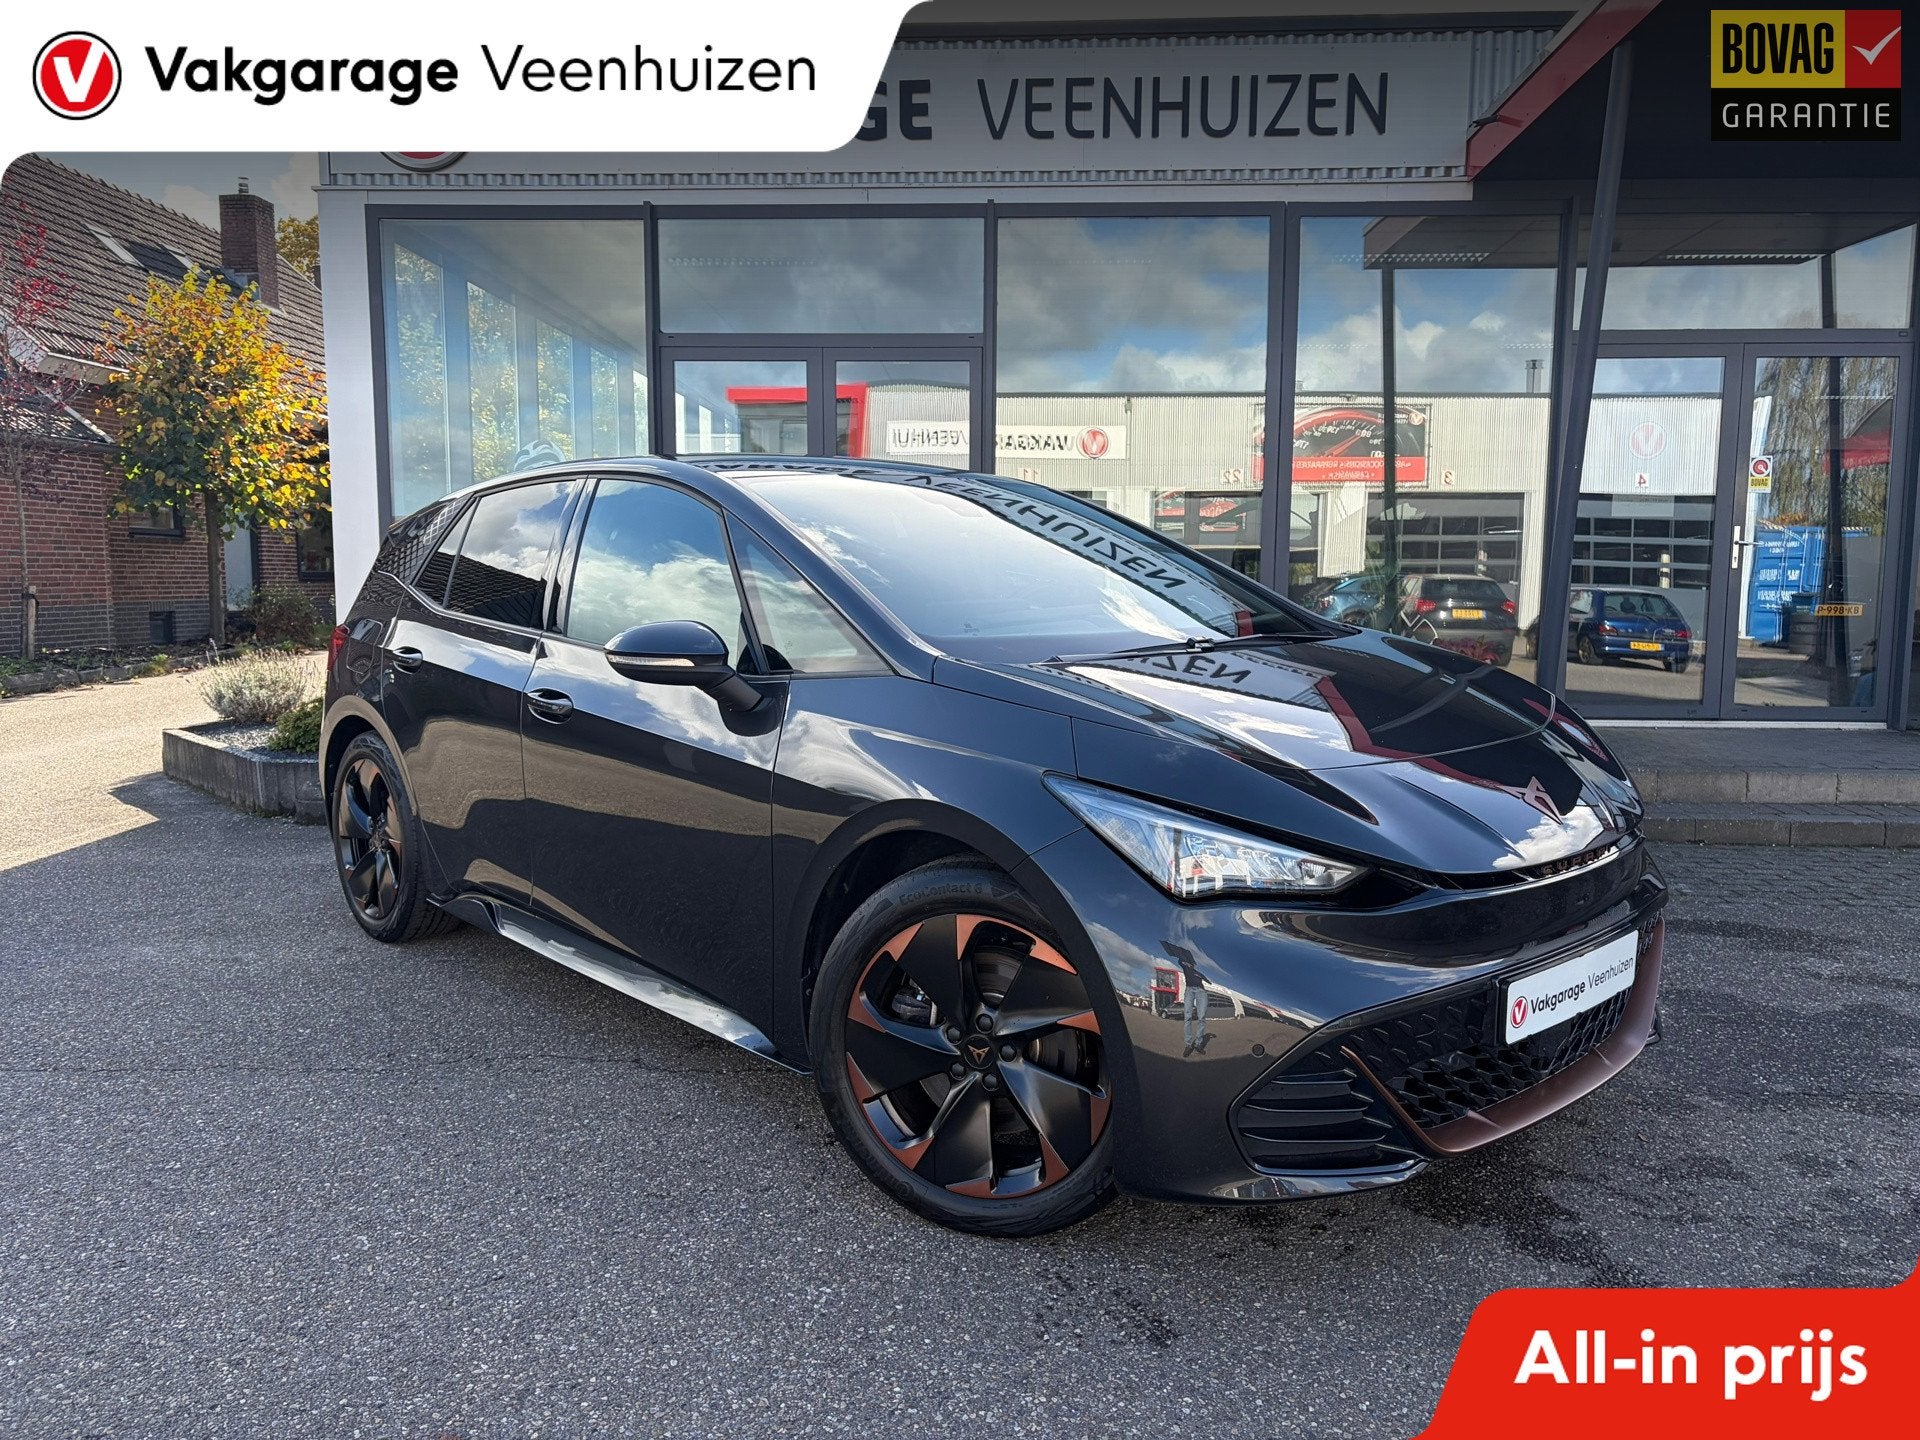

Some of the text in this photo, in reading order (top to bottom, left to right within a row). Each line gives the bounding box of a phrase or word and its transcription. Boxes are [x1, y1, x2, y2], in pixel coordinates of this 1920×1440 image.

[976, 72, 1389, 140] VEENHUIZEN
[1530, 981, 1586, 1015] Vakgarage
[1587, 957, 1634, 989] Veenhuizen
